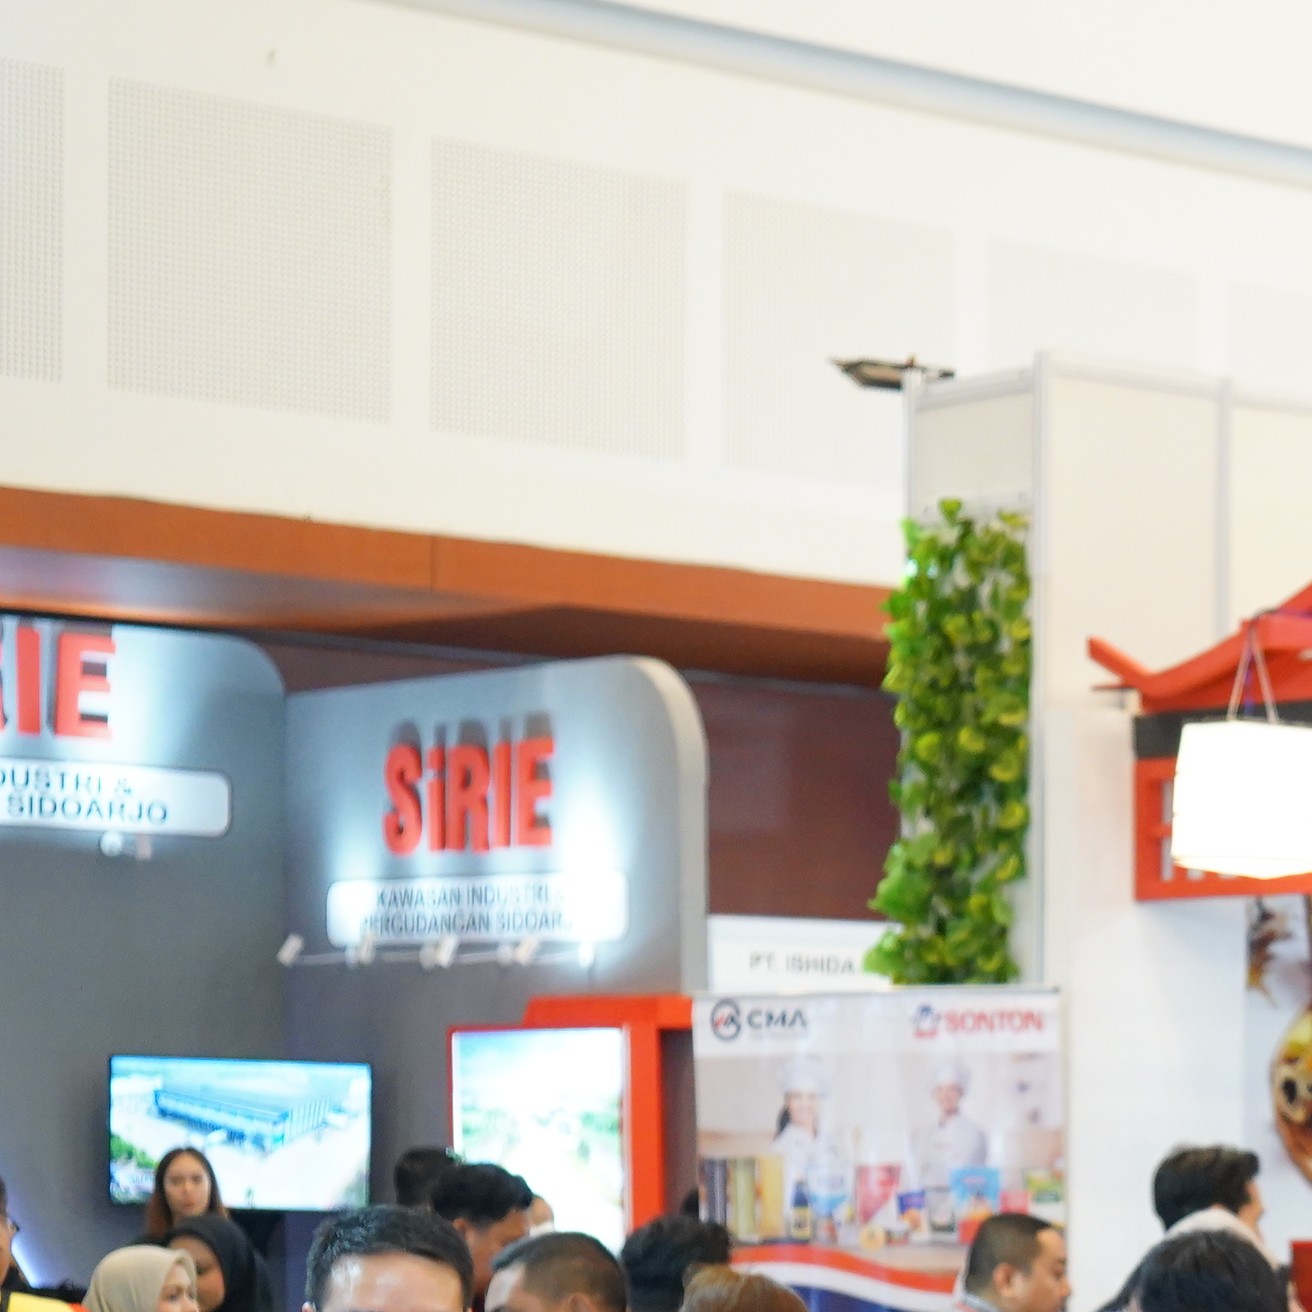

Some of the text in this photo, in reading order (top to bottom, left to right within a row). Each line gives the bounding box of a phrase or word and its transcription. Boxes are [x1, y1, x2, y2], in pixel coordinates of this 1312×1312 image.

[0, 626, 116, 742] IE
[8, 793, 168, 825] SIDOARJO
[377, 887, 460, 909] KAWASAN
[784, 953, 854, 974] ISHIDA
[747, 1007, 808, 1030] CMA
[944, 1009, 1044, 1034] SONTON
